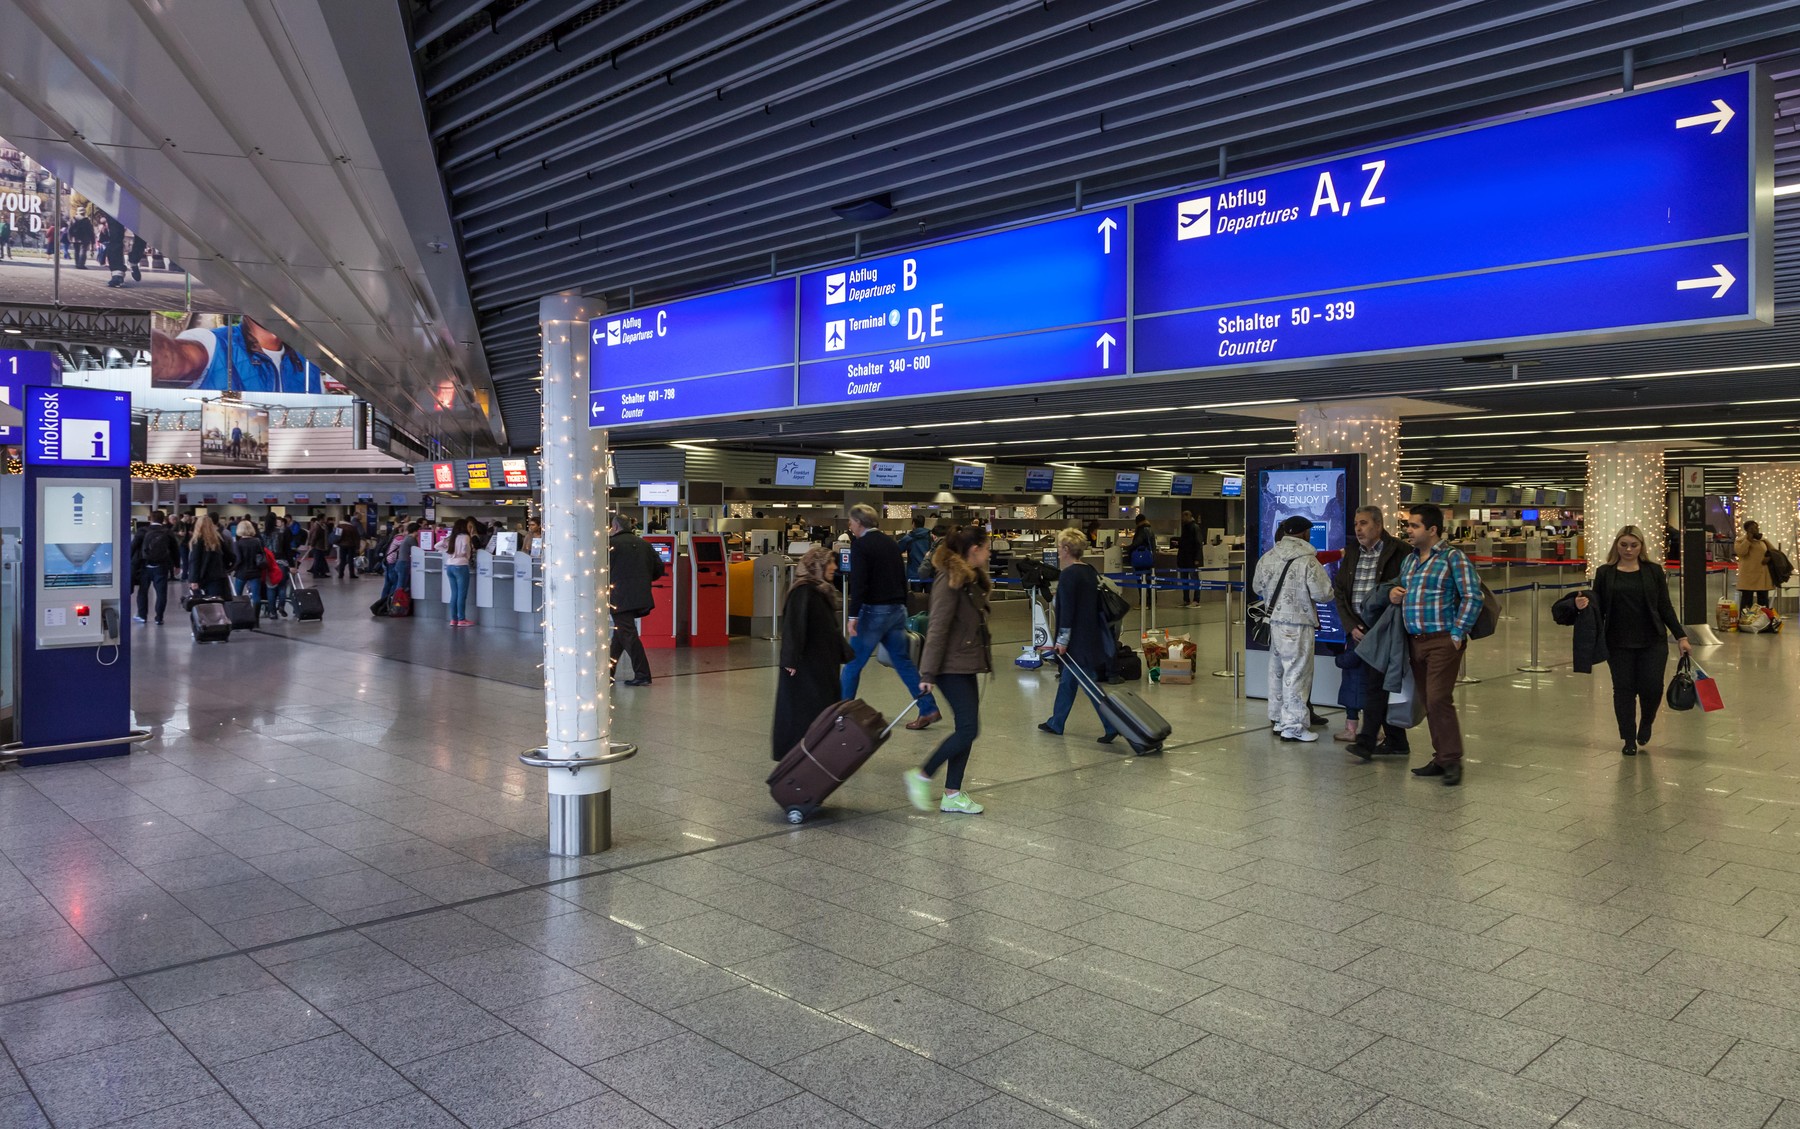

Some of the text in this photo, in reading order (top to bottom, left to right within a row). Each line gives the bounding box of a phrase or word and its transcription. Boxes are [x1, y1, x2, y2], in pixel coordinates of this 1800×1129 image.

[1217, 188, 1266, 210] Abflug
[1216, 206, 1299, 234] Departures
[849, 268, 878, 284] Abflug
[903, 258, 918, 292] B
[848, 283, 896, 302] Departures
[622, 317, 642, 330] Abflug
[656, 310, 667, 337] C
[849, 313, 886, 331] Terminal
[1218, 314, 1281, 334] Schalter
[622, 329, 654, 344] Departures
[1218, 338, 1278, 358] Counter
[9, 356, 17, 374] 1
[848, 362, 884, 378] Schalter
[848, 382, 881, 395] Counter
[621, 392, 645, 405] Schalter
[621, 408, 644, 419] Counter
[39, 392, 59, 460] Infokiosk
[1276, 483, 1328, 492] THE OTHER
[1275, 495, 1330, 504] TO ENJOY IT
